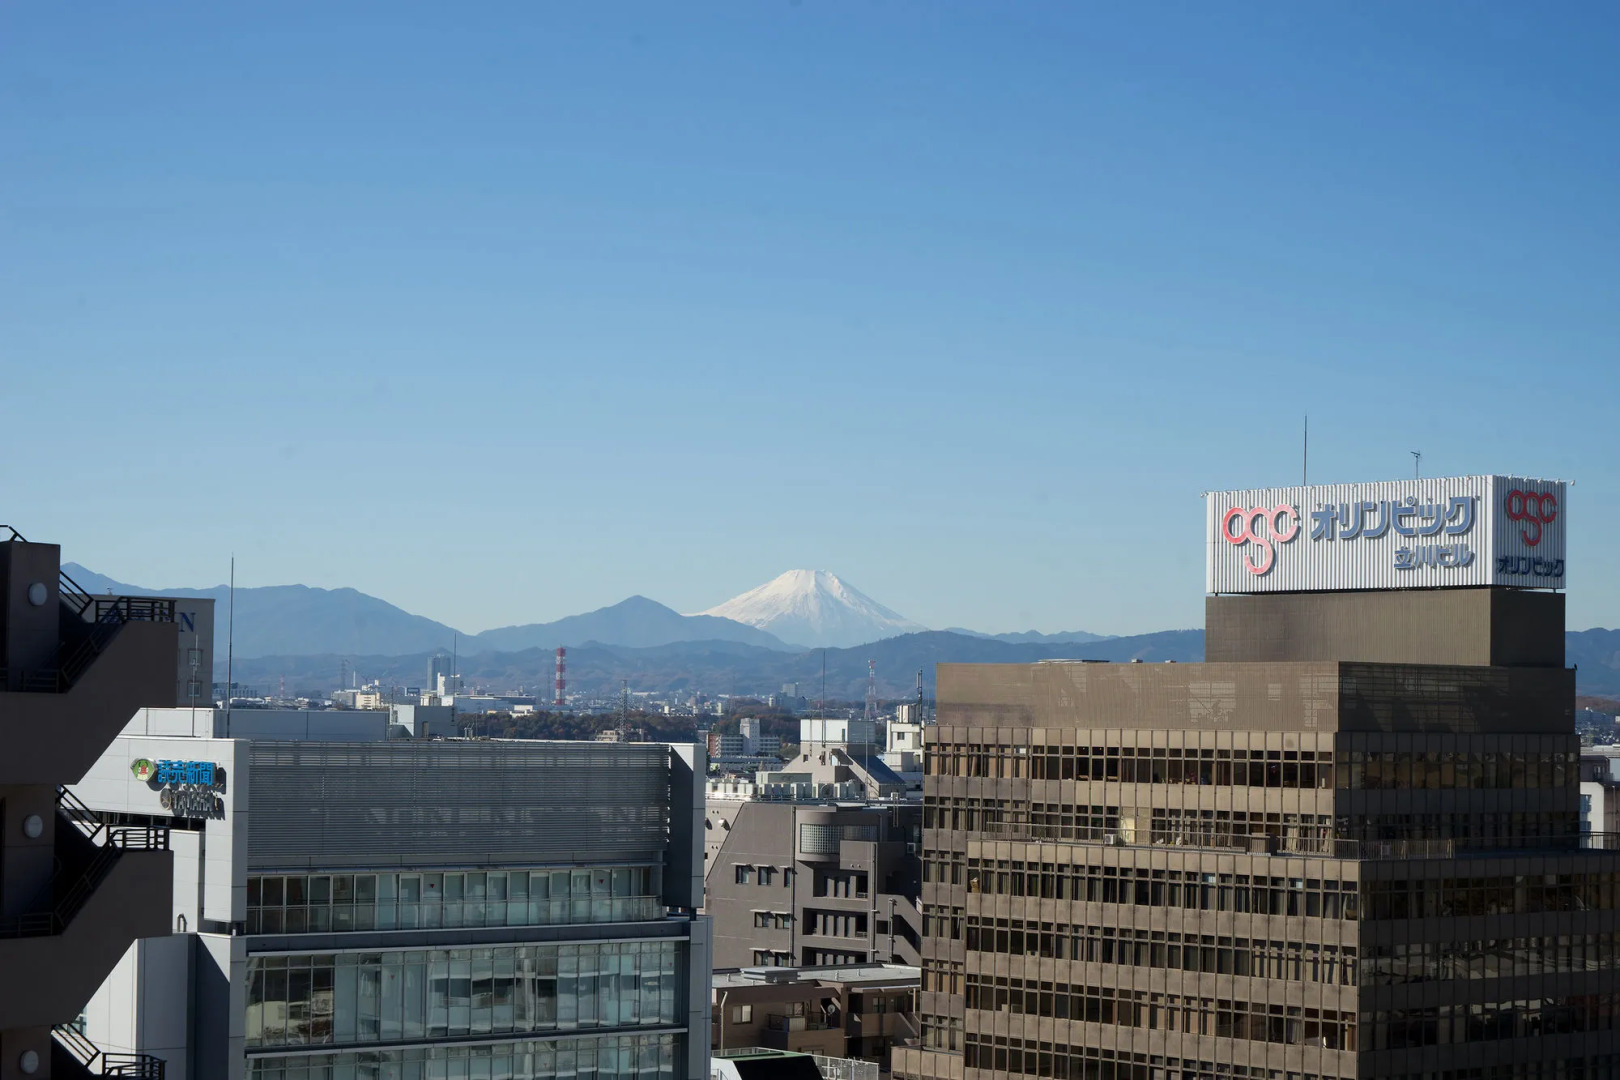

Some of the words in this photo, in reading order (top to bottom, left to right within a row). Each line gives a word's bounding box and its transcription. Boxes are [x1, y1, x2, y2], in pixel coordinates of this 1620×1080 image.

[1310, 495, 1473, 541] オリンピック
[1393, 543, 1473, 569] 立川ビル
[1498, 555, 1565, 578] オリンピック
[157, 759, 214, 787] 読売新聞
